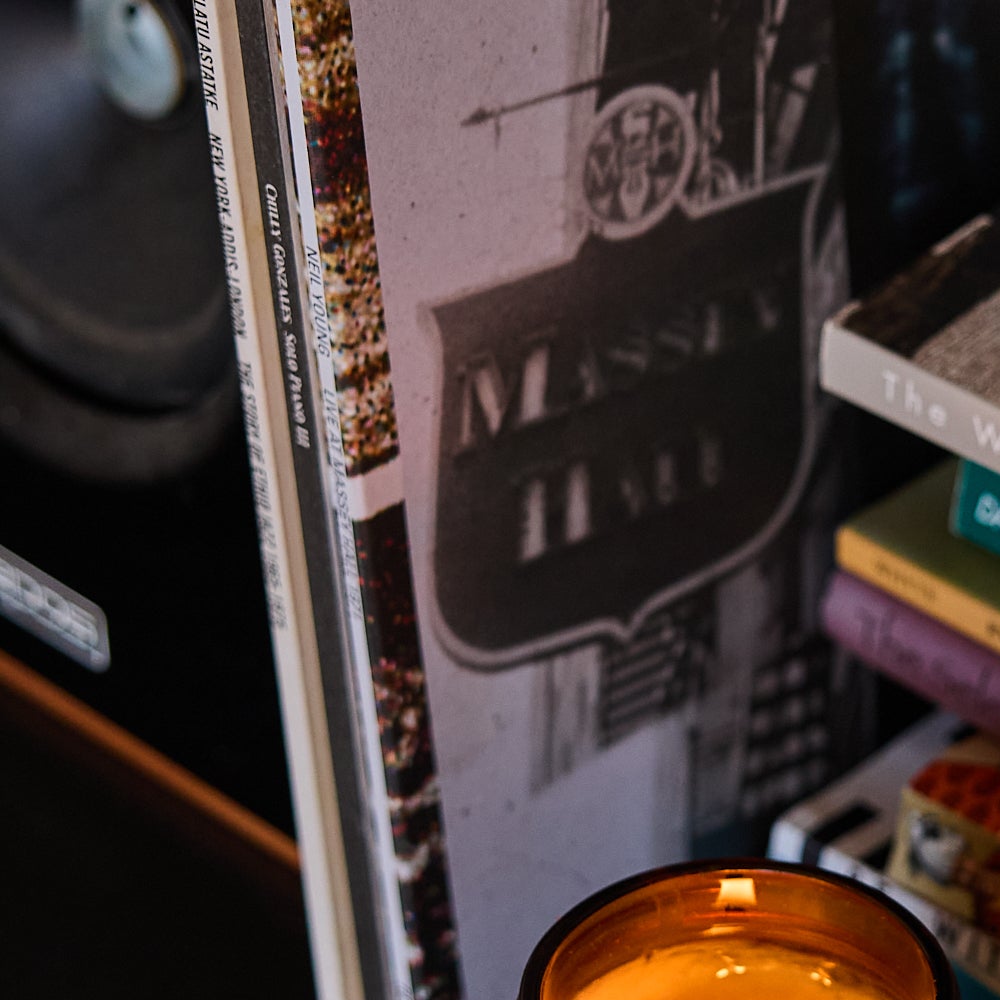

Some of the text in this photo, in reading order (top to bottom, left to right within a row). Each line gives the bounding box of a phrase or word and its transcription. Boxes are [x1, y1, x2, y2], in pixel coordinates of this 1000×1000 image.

[194, 0, 219, 111] LATU ASTATKE
[208, 132, 226, 171] NEW
[306, 245, 331, 359] NEIL YOUNG
[323, 388, 339, 431] LIVE
[880, 369, 948, 428] The
